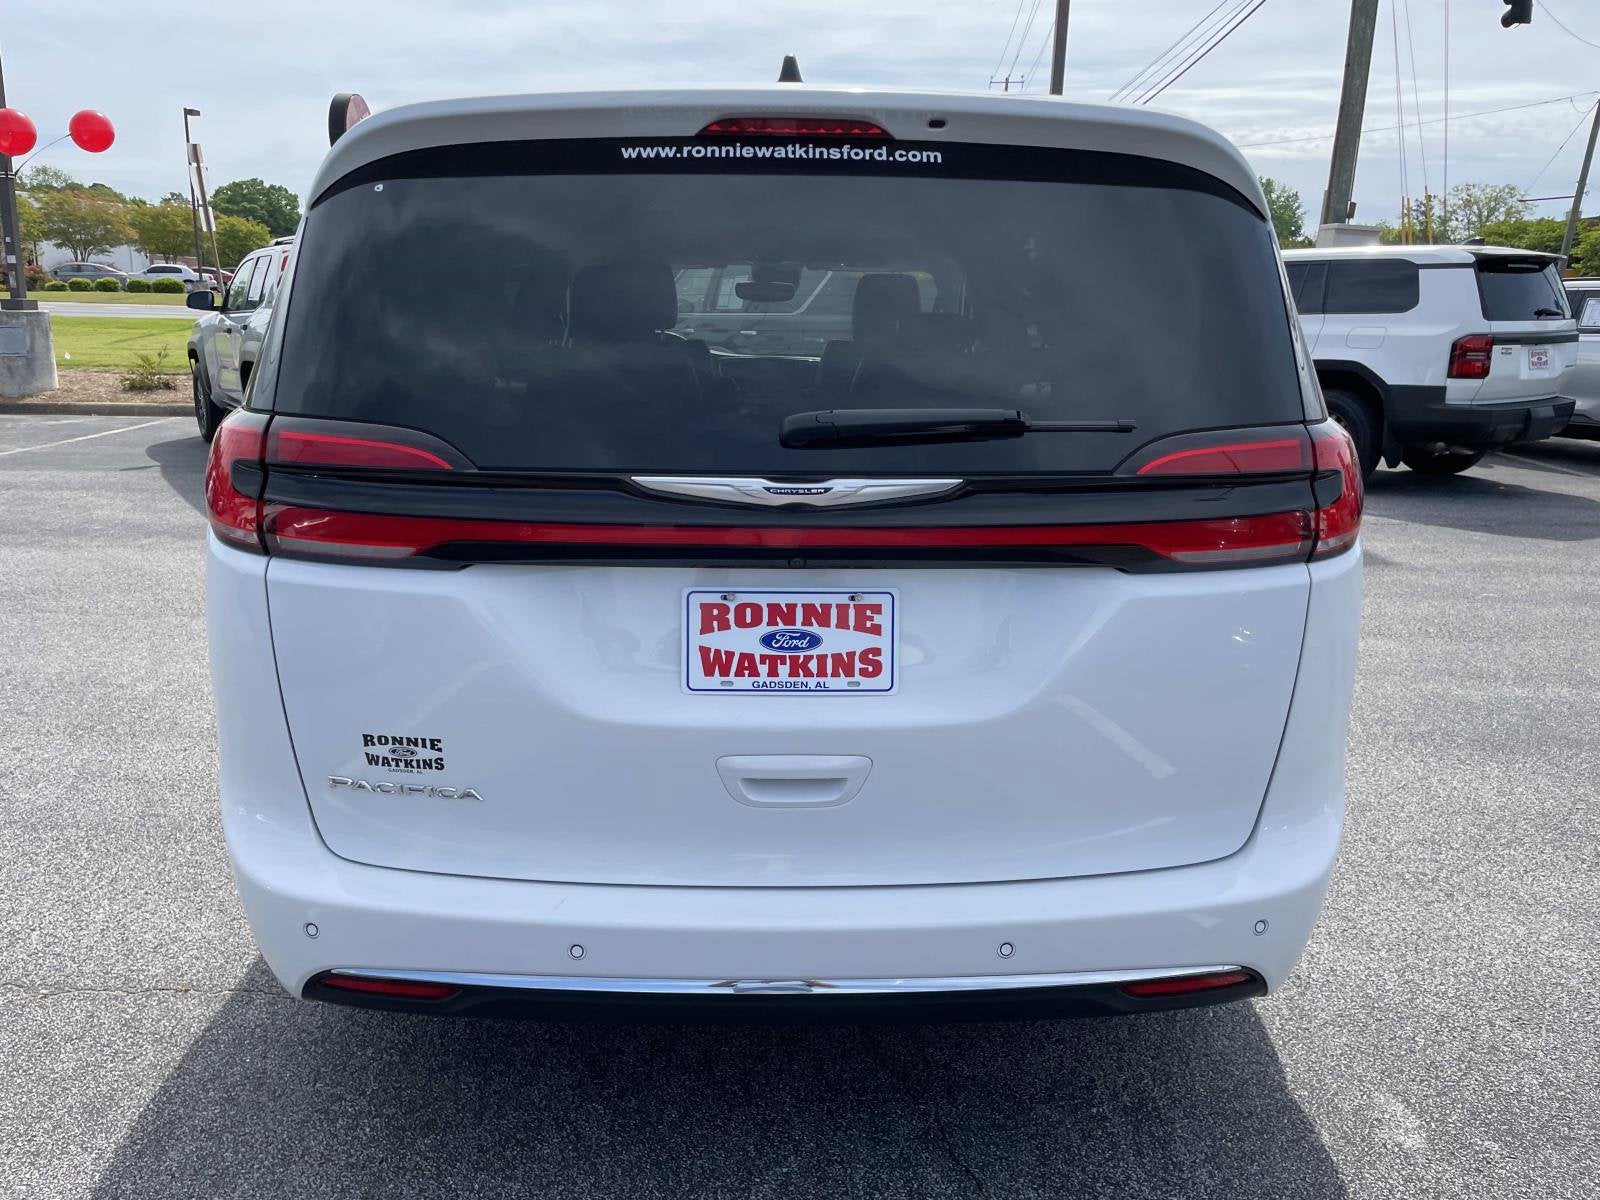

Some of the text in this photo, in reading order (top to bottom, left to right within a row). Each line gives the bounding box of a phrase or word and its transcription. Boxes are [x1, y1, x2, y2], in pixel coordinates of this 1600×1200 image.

[620, 142, 943, 164] www.ronniewatkinsford.com
[699, 602, 883, 637] RONNIE
[771, 631, 810, 649] Ford
[698, 645, 883, 679] WATKINS
[751, 680, 830, 690] GADSDEN, AL
[361, 733, 443, 753] RONNIE
[364, 752, 445, 771] WATKINS
[327, 775, 485, 801] PACIFICA
